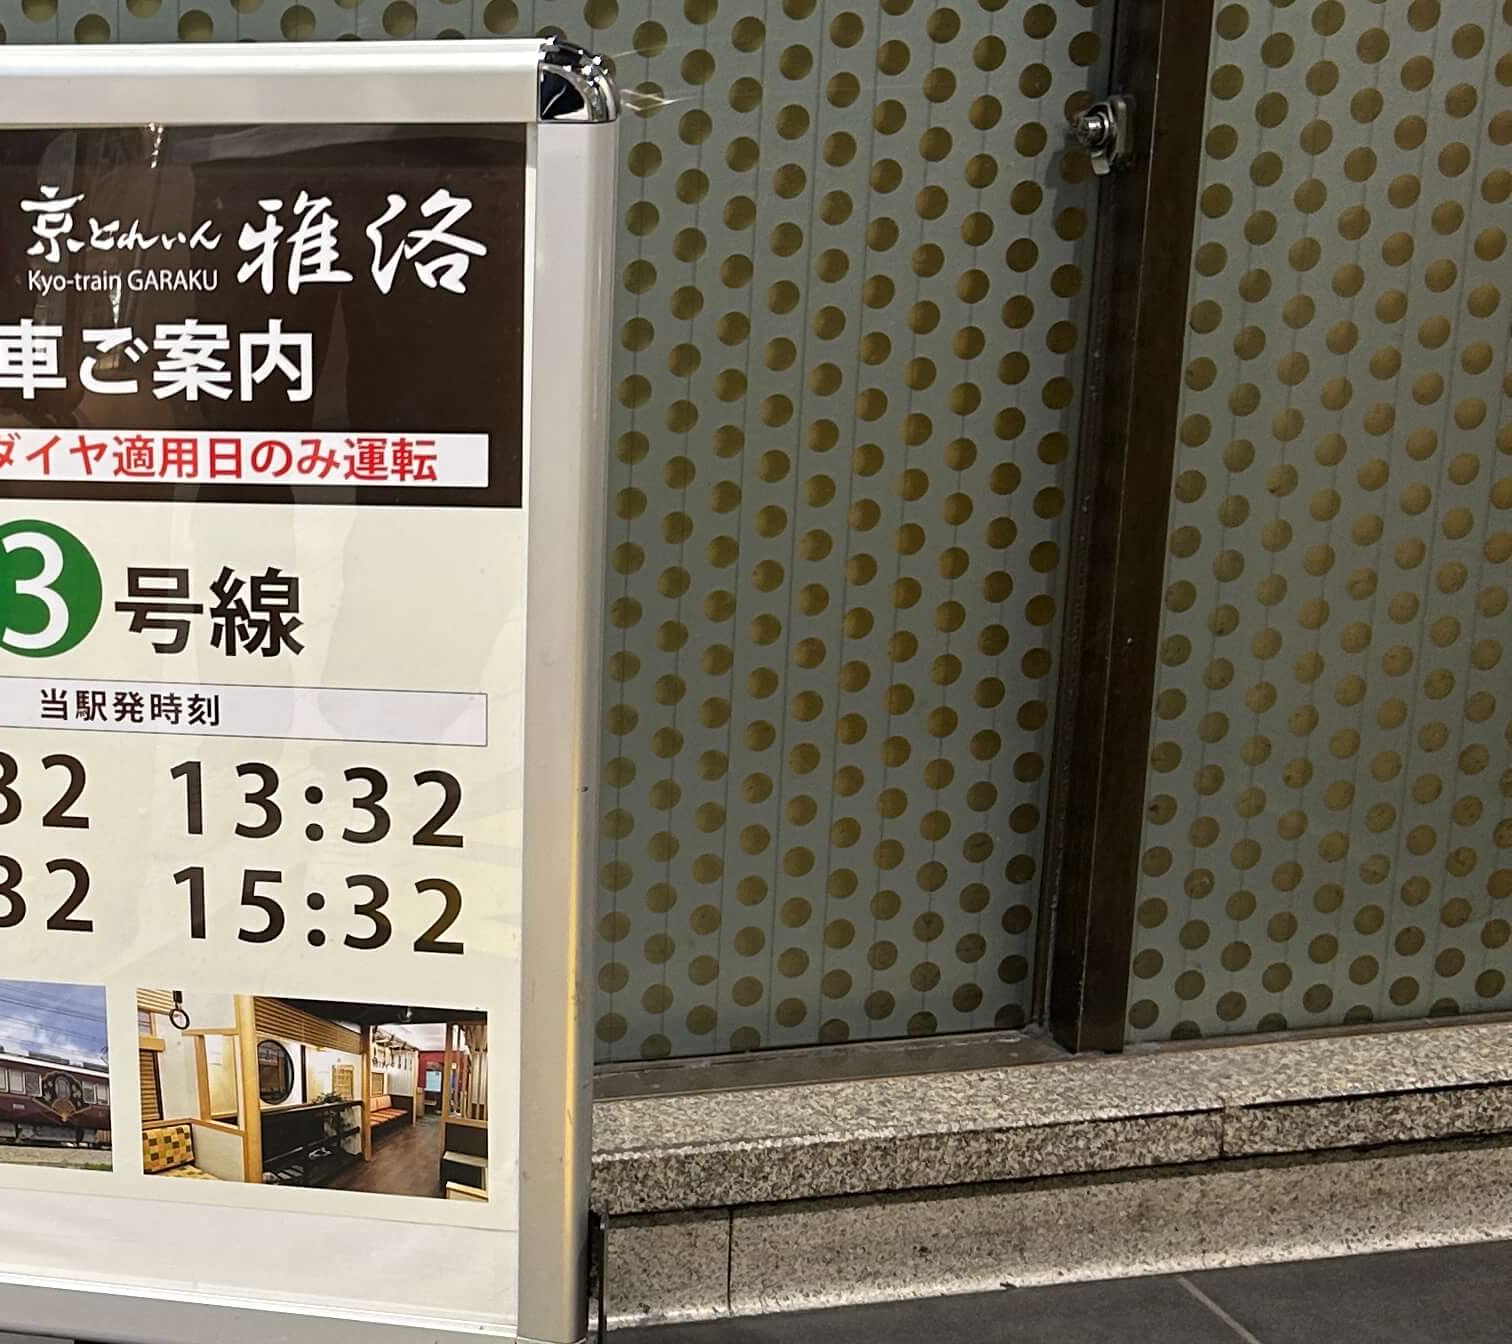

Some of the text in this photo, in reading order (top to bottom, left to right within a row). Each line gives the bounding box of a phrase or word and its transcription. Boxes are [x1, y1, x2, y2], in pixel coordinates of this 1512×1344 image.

[28, 269, 218, 295] Kyo-train GARAKU
[1, 531, 70, 650] 3
[114, 565, 305, 658] 号線
[40, 688, 220, 727] 当駅発時刻
[170, 760, 464, 849] 13:32
[173, 866, 465, 955] 15:32
